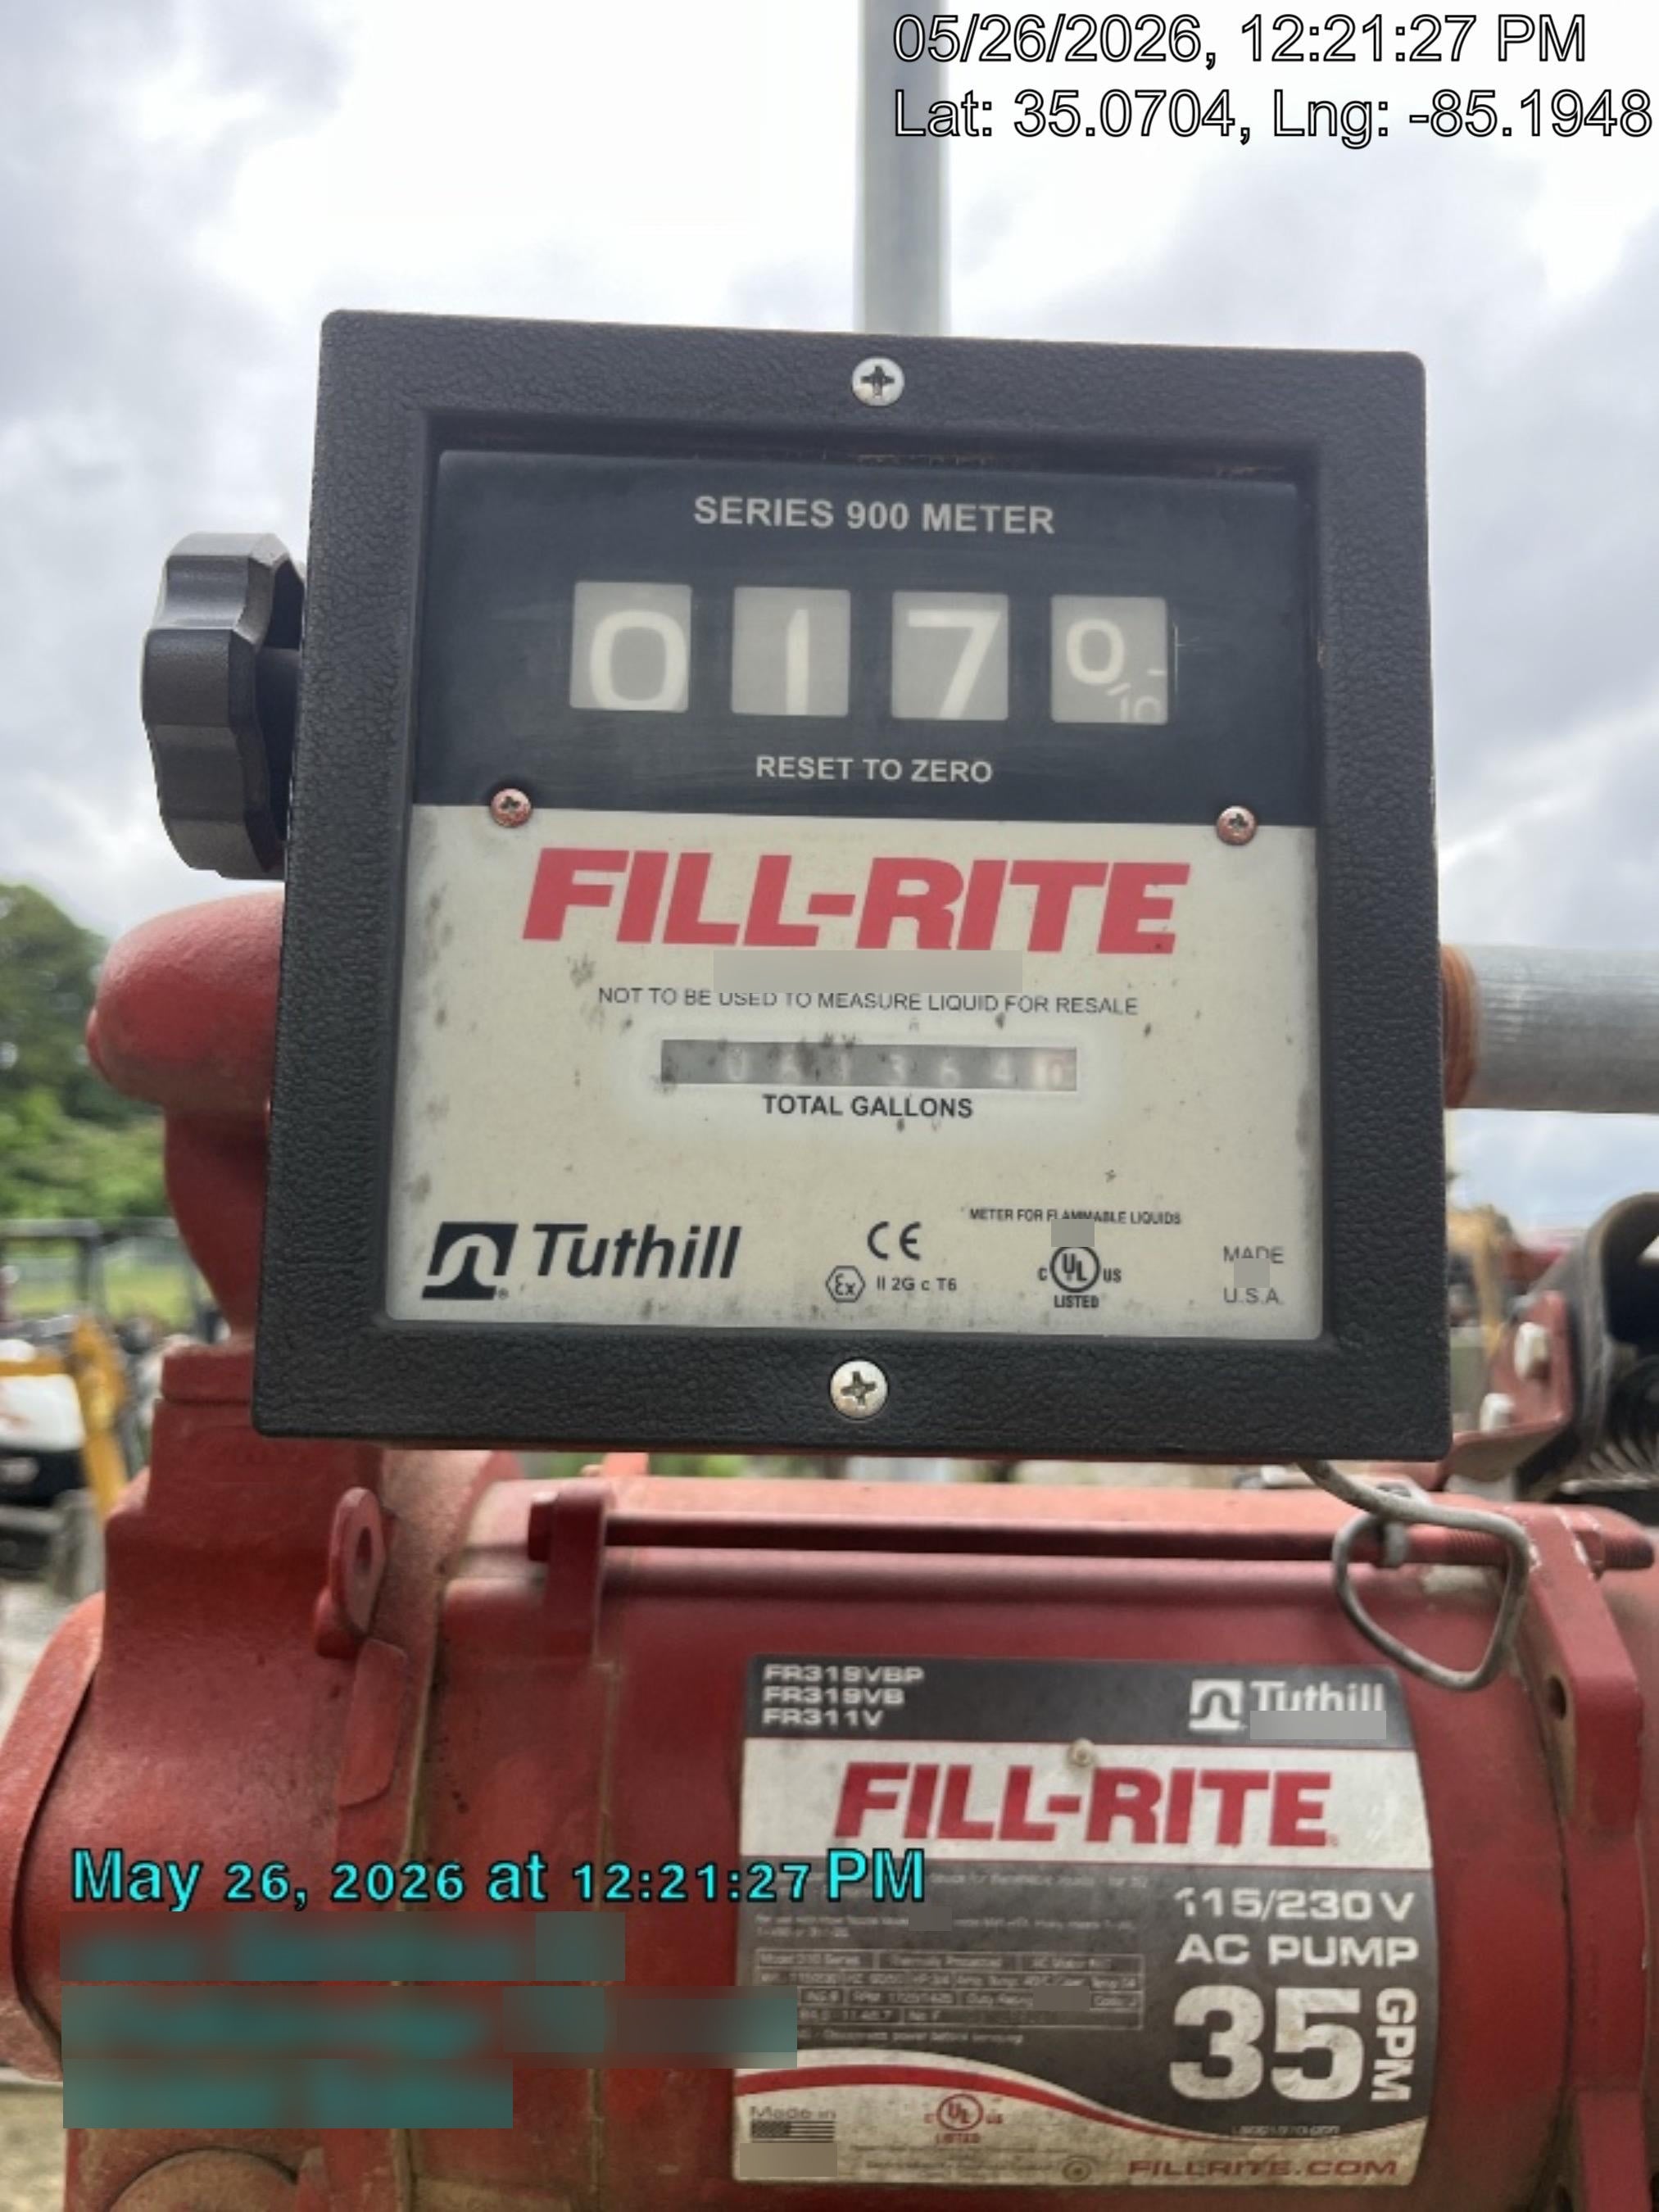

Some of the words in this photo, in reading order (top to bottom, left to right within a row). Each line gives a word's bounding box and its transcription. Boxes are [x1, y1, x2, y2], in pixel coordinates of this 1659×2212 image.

[694, 495, 833, 529] SERIES
[845, 501, 910, 533] 900
[921, 502, 1055, 536] METER
[755, 755, 853, 781] RESET
[862, 758, 904, 782] TO
[911, 759, 993, 784] ZERO
[522, 847, 1191, 954] FILL-RITE
[599, 987, 643, 1004] NOT
[649, 988, 677, 1005] TO
[685, 989, 711, 1005] BE
[718, 992, 777, 1006] USED
[784, 992, 812, 1009] TO
[818, 992, 922, 1011] MEASURE
[928, 994, 999, 1012] LIQUID
[1004, 995, 1049, 1013] FOR
[1056, 997, 1139, 1016] RESALE
[762, 1093, 843, 1116] TOTAL
[850, 1095, 974, 1119] GALLONS
[970, 1208, 1013, 1221] METER
[1017, 1208, 1043, 1222] FOR
[1046, 1209, 1126, 1224] FLAMMABLE
[1130, 1211, 1181, 1226] LIQUIDS
[533, 1222, 742, 1280] Tuthill
[1223, 1245, 1285, 1264] MADE
[891, 1276, 916, 1292] 2G
[936, 1277, 958, 1292] T6
[1102, 1268, 1122, 1282] US
[1053, 1294, 1100, 1308] LISTED
[1223, 1286, 1285, 1305] U.S.A.
[1249, 1680, 1385, 1711] Tuthill
[761, 1707, 885, 1728] FR311V
[834, 1761, 1333, 1848] FILL-RITE
[1173, 1887, 1374, 1923] 115/230
[1378, 1892, 1416, 1922] V
[1175, 1933, 1251, 1965] AC
[1267, 1936, 1420, 1968] PUMP
[1169, 1984, 1365, 2102] 35
[1370, 1987, 1419, 2103] GPM
[1127, 2160, 1398, 2177] FILLRITE.COM
